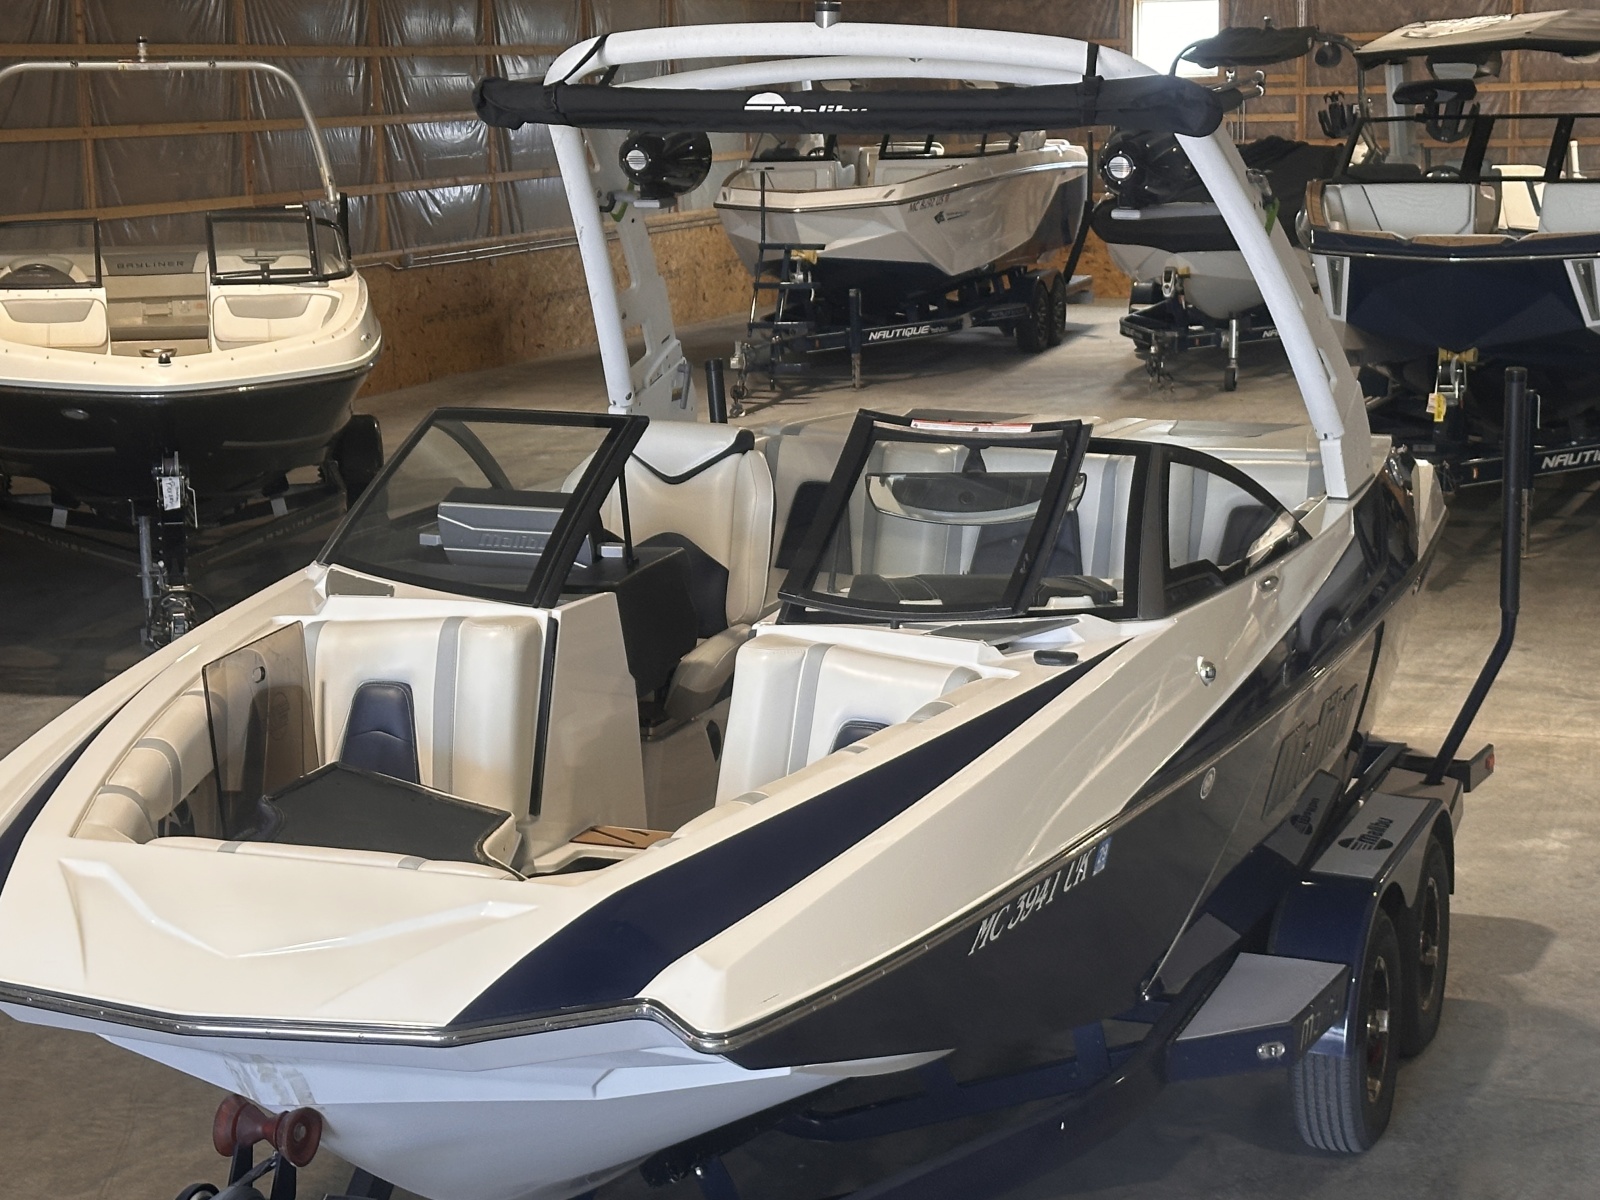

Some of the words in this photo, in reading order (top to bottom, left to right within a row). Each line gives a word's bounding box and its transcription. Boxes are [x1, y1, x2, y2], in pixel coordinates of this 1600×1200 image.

[116, 261, 184, 269] BAYLINER
[868, 325, 930, 341] NAUTIQUE
[1541, 449, 1600, 470] NAUTI
[967, 903, 1011, 957] MC
[1007, 869, 1062, 930] 3941
[1063, 846, 1097, 893] UK
